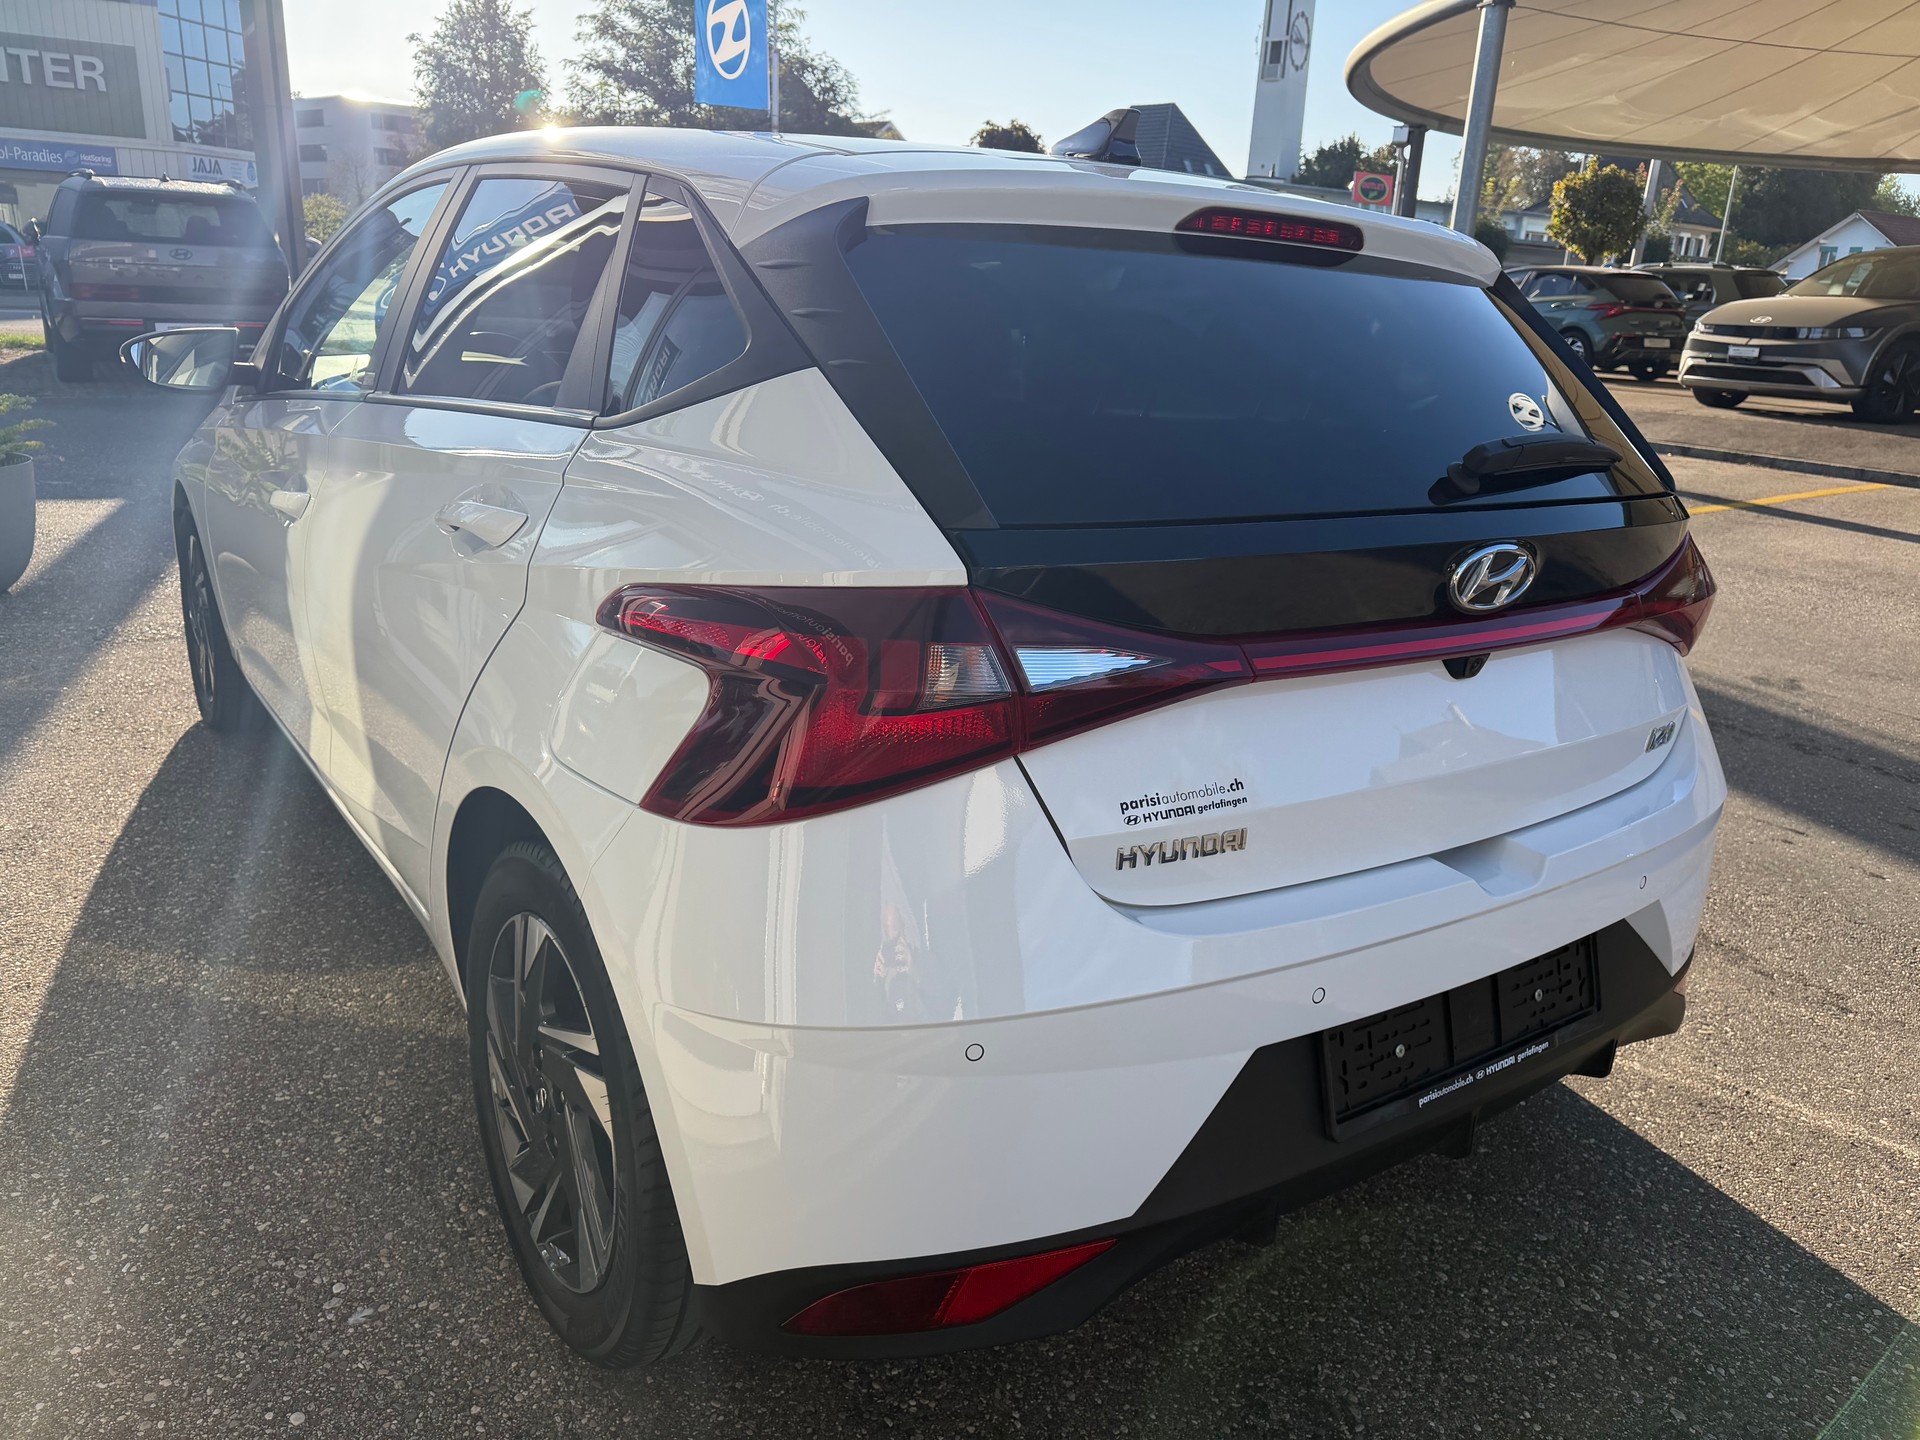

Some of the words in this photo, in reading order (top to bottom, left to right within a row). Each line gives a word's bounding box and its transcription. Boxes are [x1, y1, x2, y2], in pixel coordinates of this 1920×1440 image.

[192, 157, 223, 175] JAJA
[1644, 721, 1675, 753] i20
[1120, 778, 1244, 814] parisiautomobile.ch
[1143, 805, 1196, 823] HYUNDAI
[1197, 796, 1248, 815] gerlafingen
[1115, 828, 1248, 870] HYUNDAI
[1418, 1074, 1474, 1108] parisiautomobile.ch
[1486, 1055, 1516, 1075] HYUNDAI
[1517, 1041, 1549, 1062] gerlafingen
